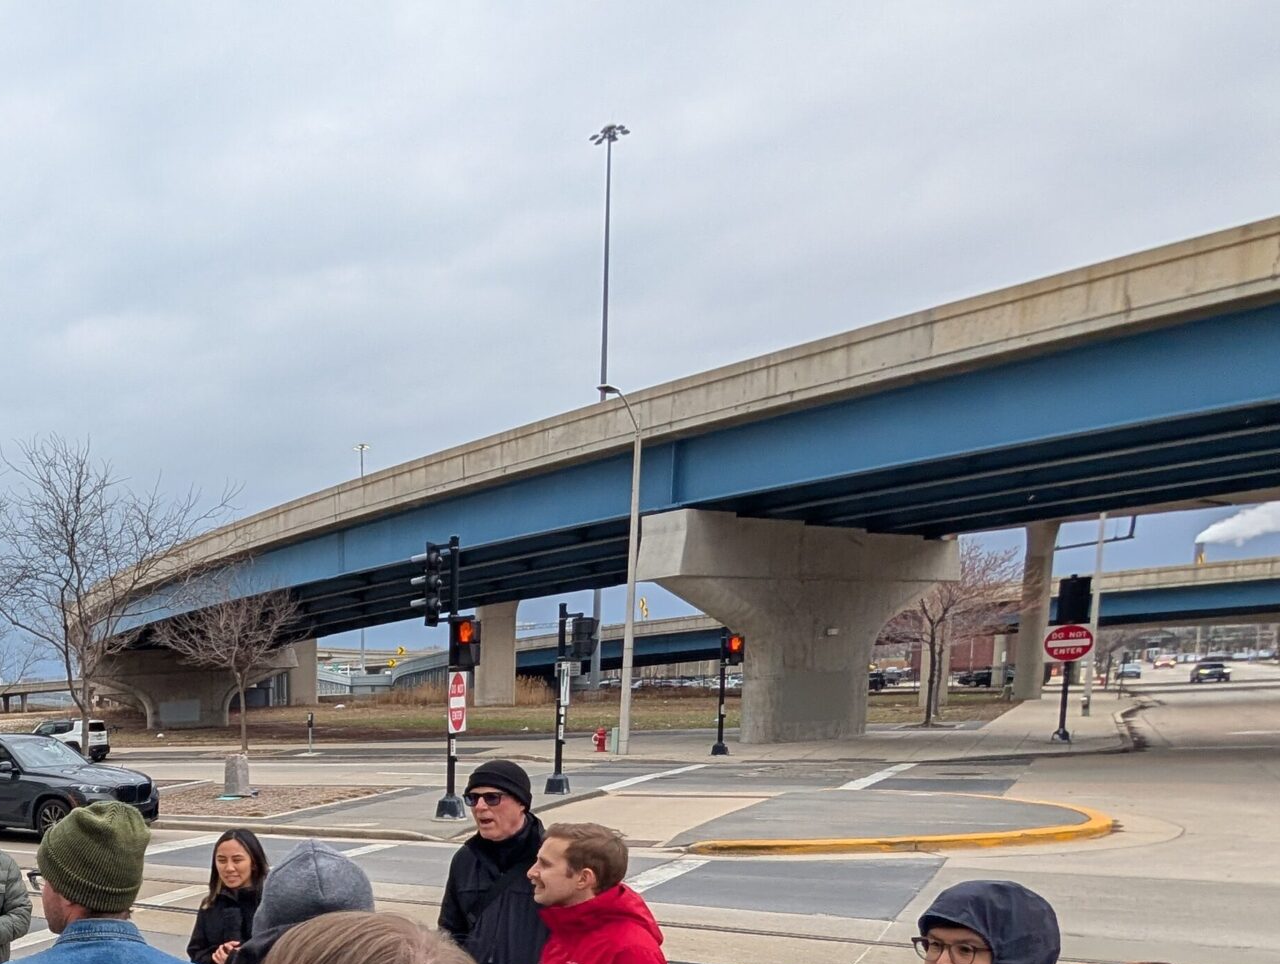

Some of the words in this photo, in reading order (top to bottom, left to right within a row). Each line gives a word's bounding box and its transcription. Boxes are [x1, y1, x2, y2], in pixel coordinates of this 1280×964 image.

[1051, 632, 1065, 640] DO
[1069, 631, 1087, 639] NOT
[1053, 648, 1083, 656] ENTER
